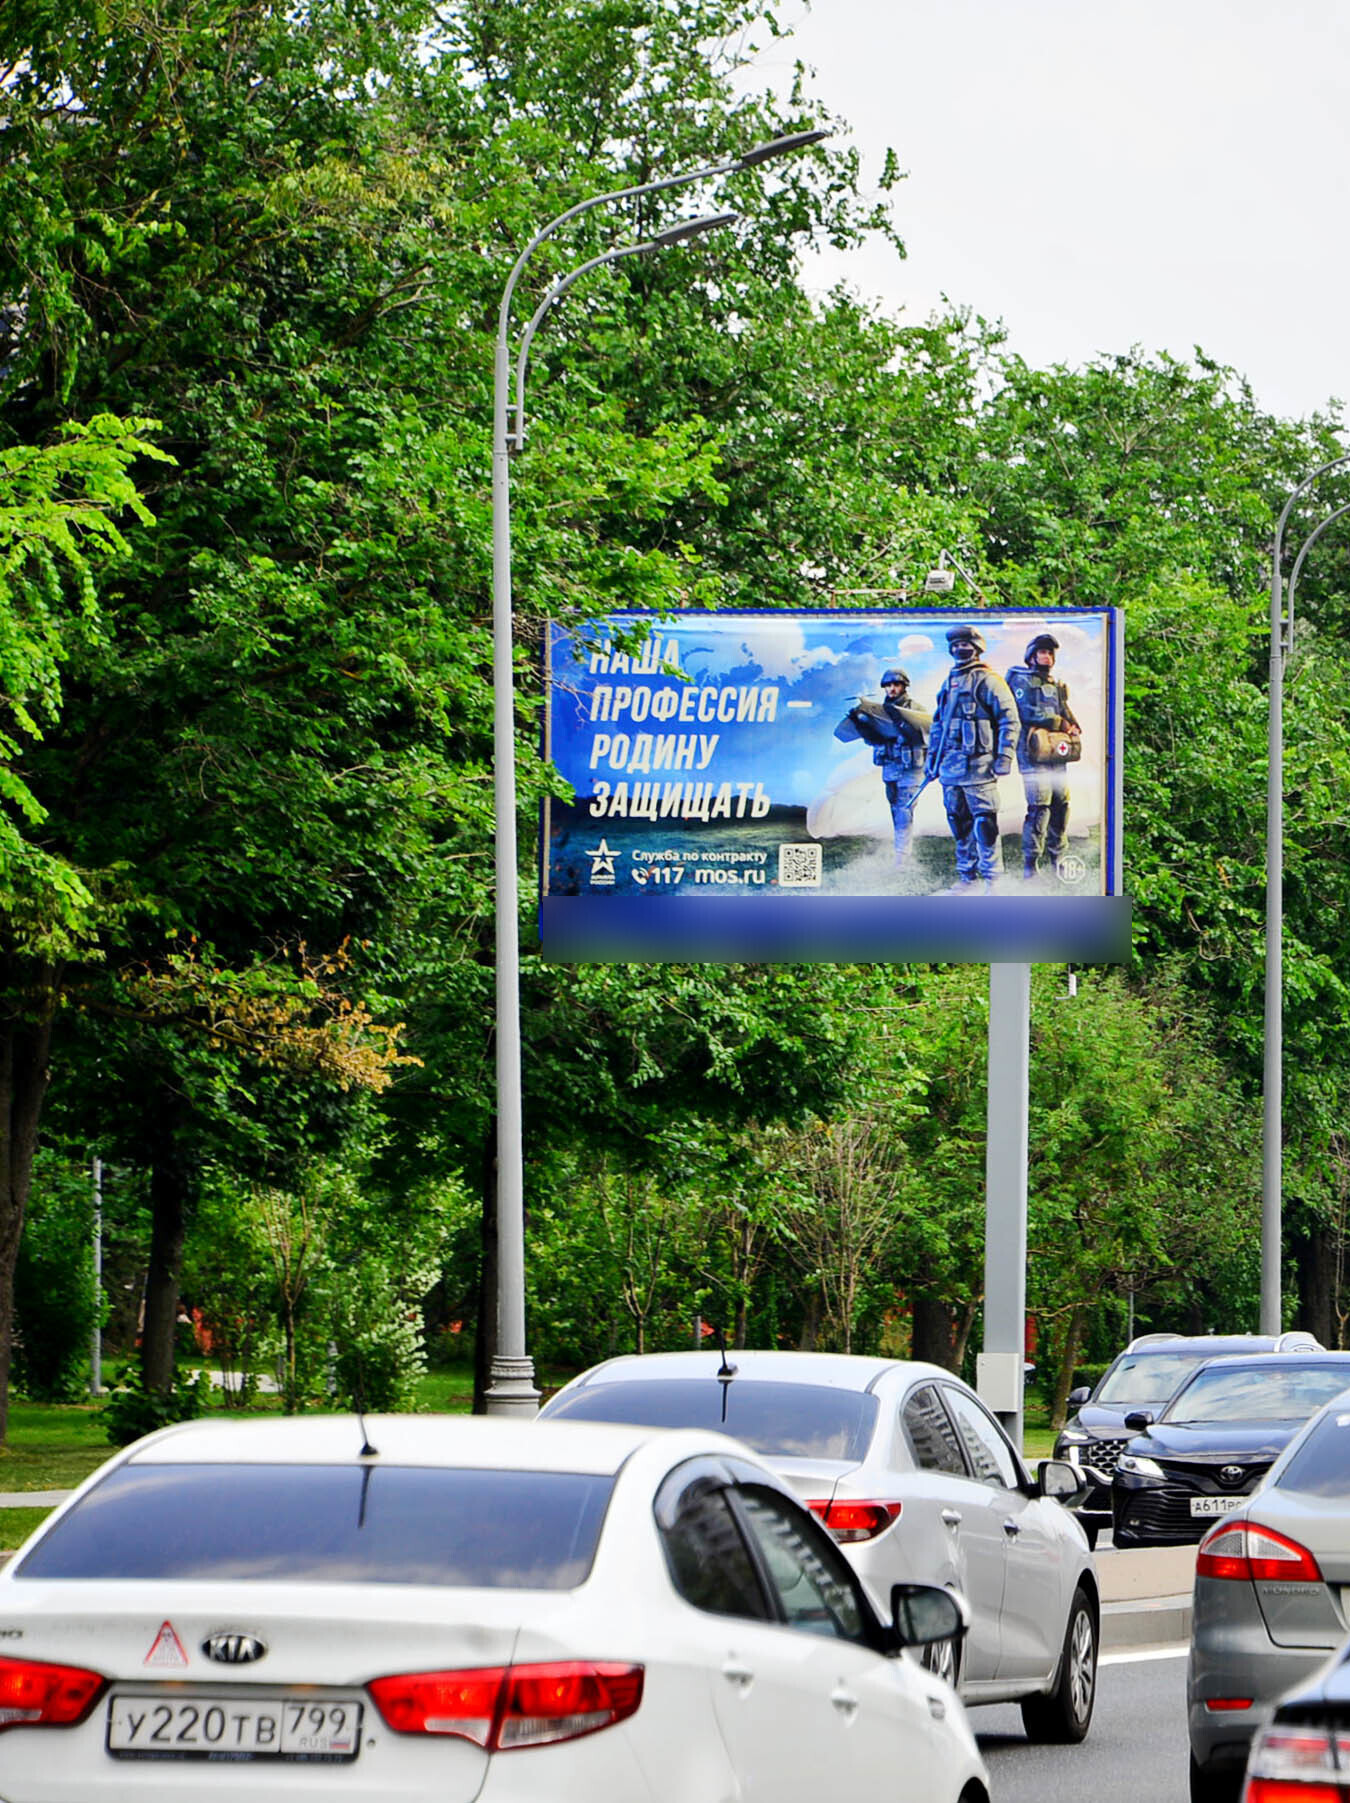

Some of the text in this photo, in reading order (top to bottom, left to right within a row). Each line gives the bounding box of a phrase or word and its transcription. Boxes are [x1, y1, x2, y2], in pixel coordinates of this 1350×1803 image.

[589, 639, 680, 674] НАША
[589, 686, 779, 722] ПРОФЕССИЯ
[589, 734, 720, 774] РОДИНУ
[589, 781, 771, 822] ЗАЩИЩАТЬ
[631, 849, 767, 864] Служба по контракту
[653, 867, 766, 884] 117 mos.ru
[209, 1635, 257, 1661] KIA
[127, 1705, 347, 1745] У220ТВ 799
[300, 1737, 329, 1748] RUS
